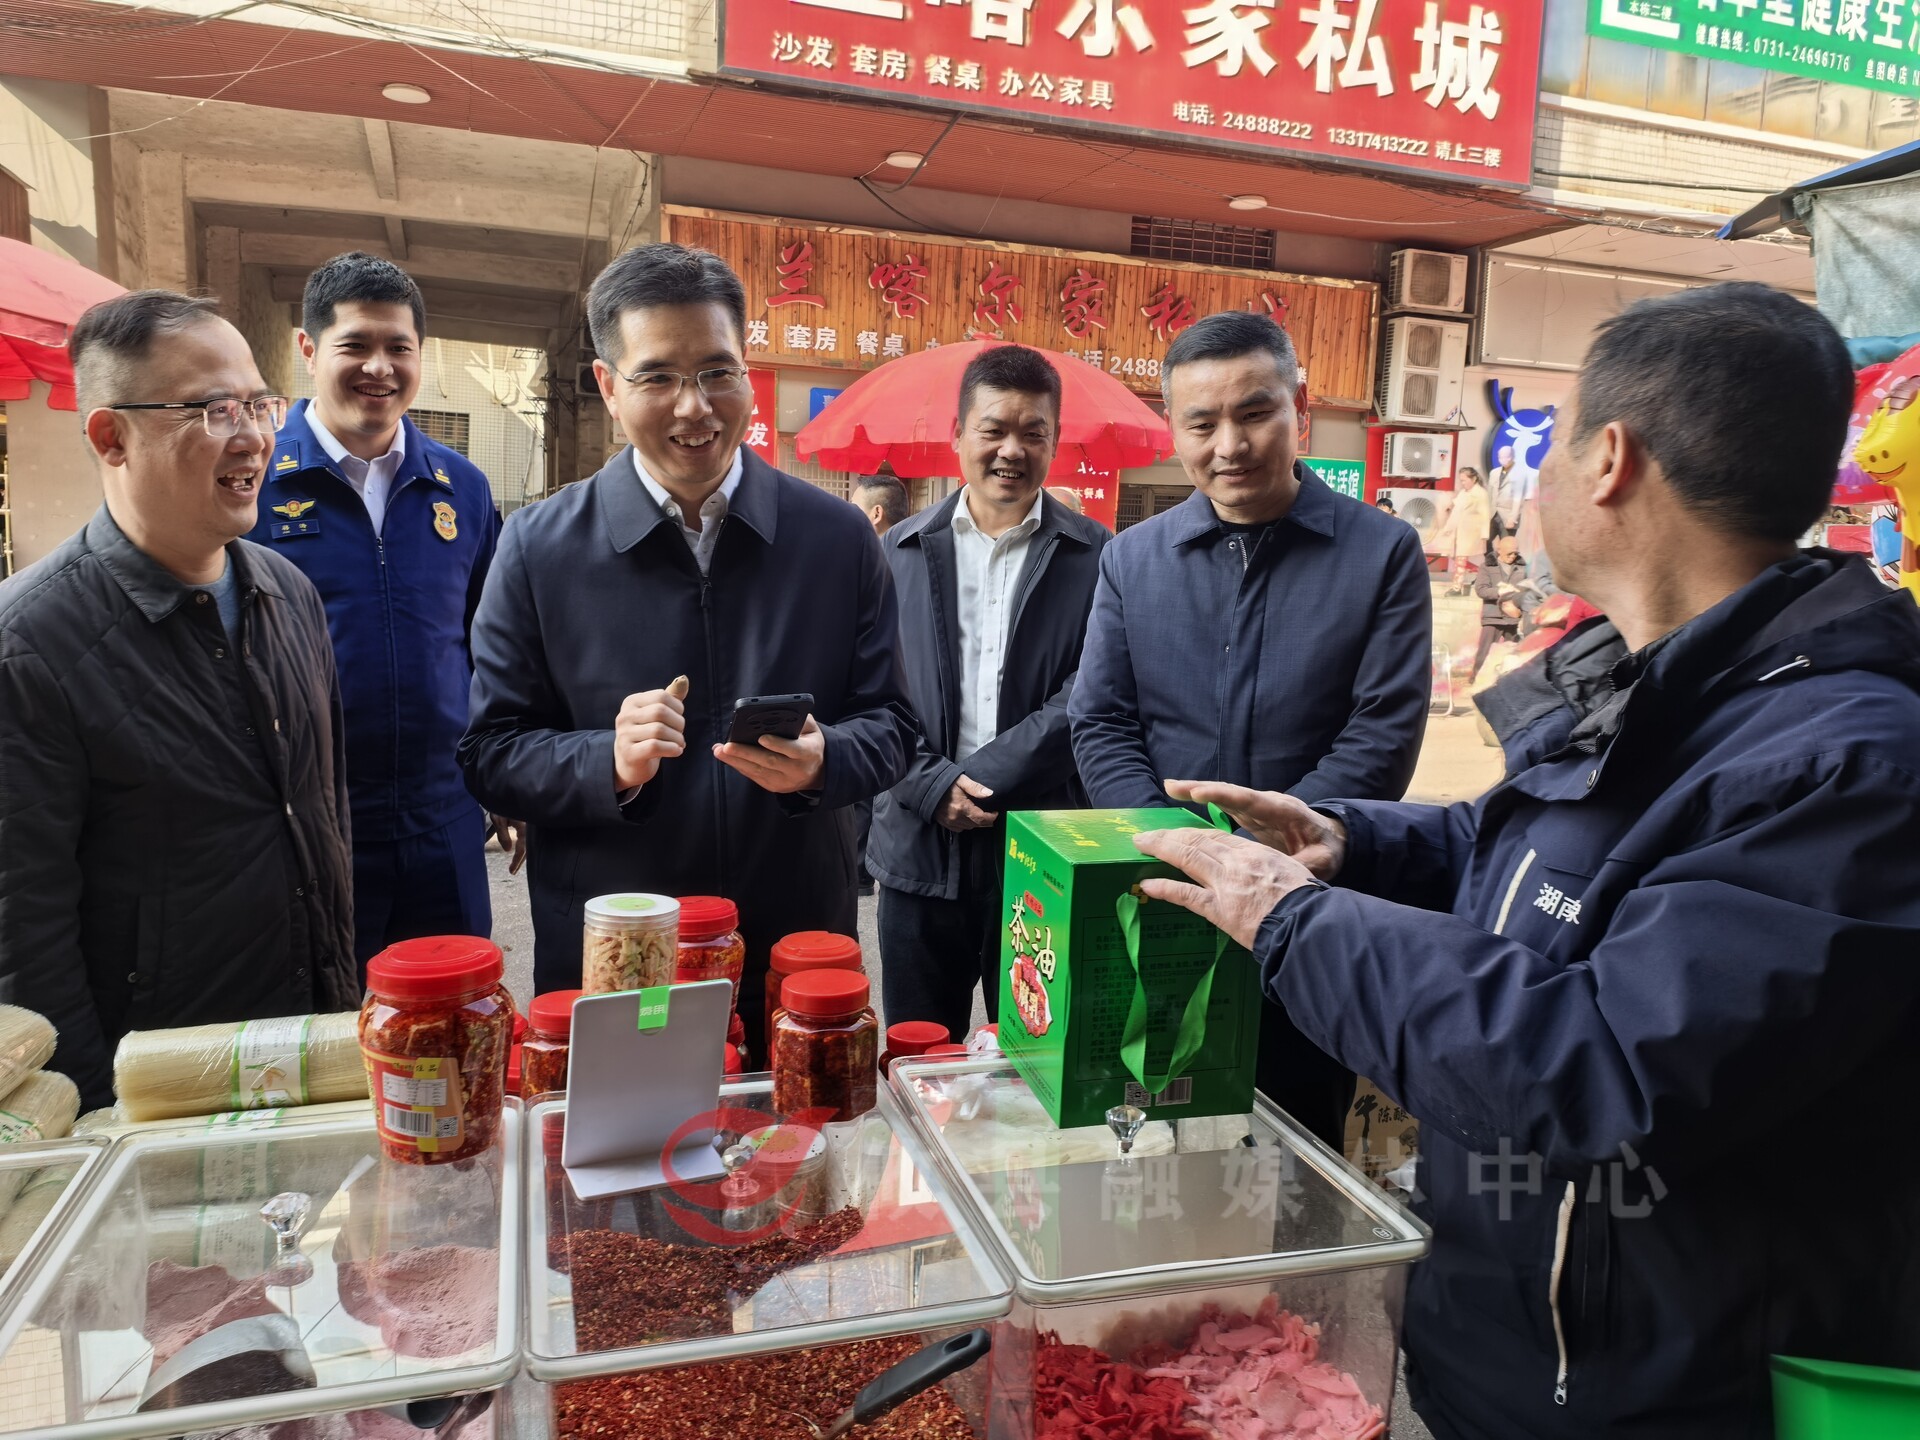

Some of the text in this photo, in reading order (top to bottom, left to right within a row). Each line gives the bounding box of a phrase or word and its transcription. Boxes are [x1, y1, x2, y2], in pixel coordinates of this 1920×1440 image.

[771, 30, 1114, 111] 沙发 套房 餐桌 办公家具
[1754, 36, 1850, 72] 0731-24696776
[1221, 111, 1313, 141] 24888222
[1326, 127, 1429, 157] 13317413222
[1434, 144, 1503, 169] 请上三楼
[747, 319, 770, 346] 发
[787, 323, 837, 352] 套房
[856, 329, 905, 358] 餐桌
[1008, 894, 1057, 982] 茶油
